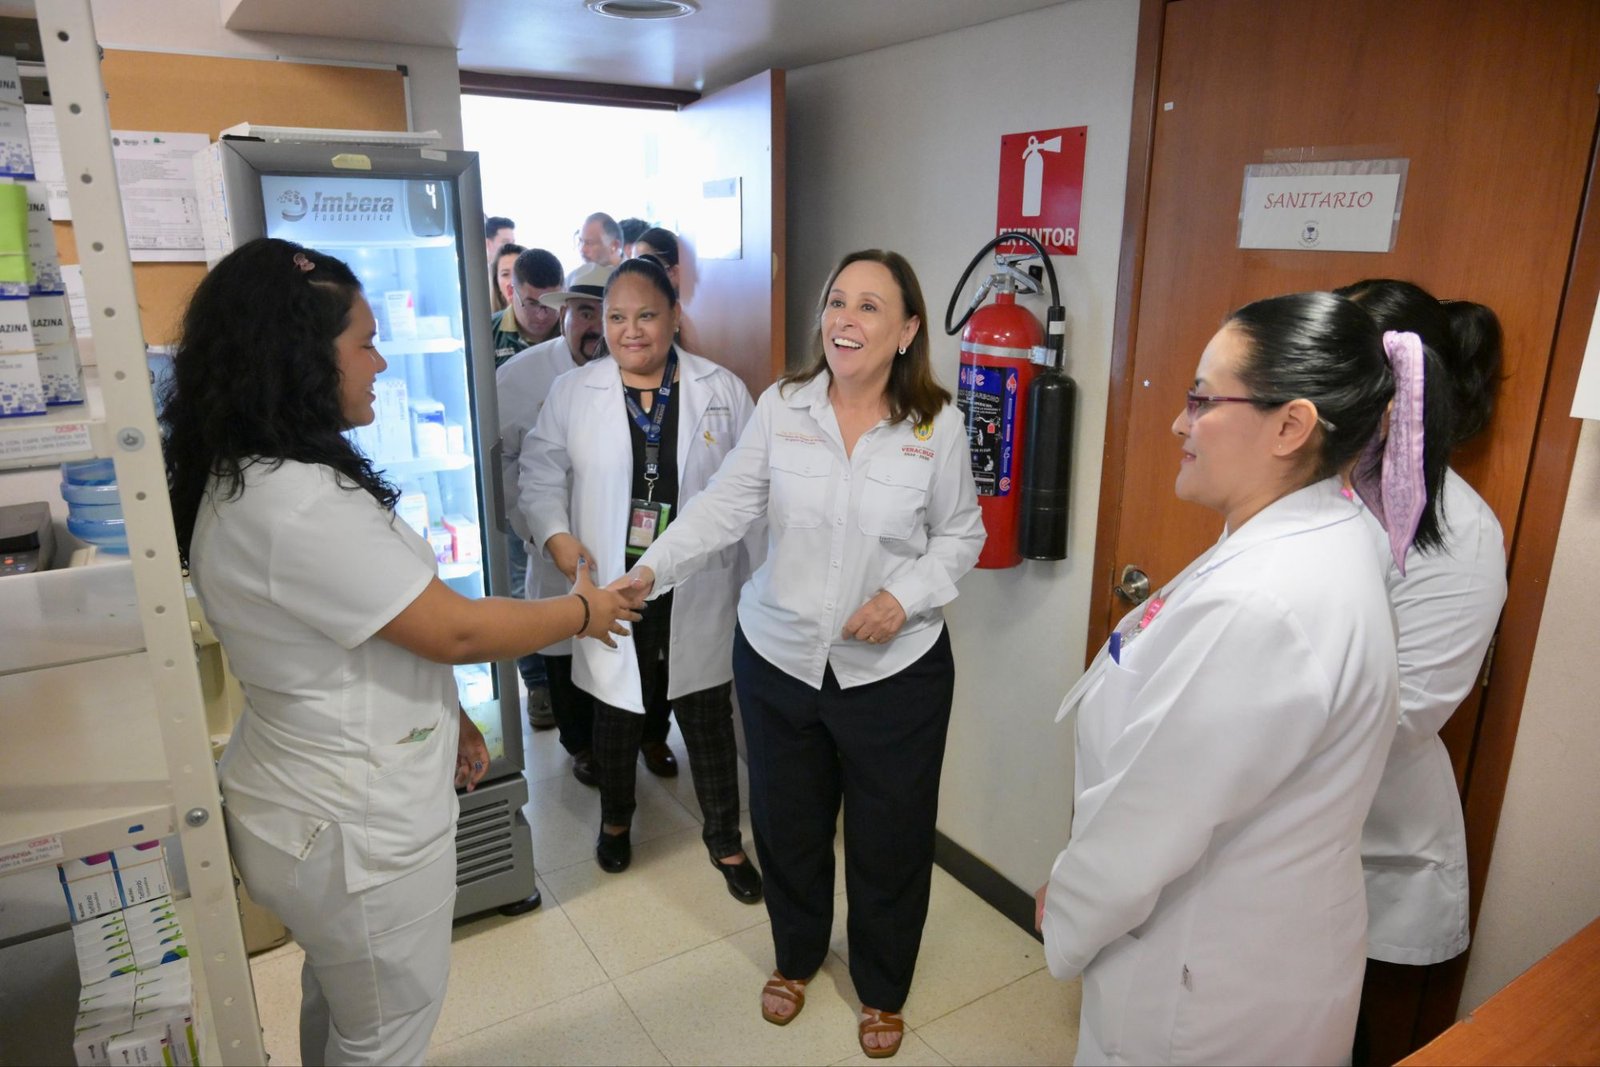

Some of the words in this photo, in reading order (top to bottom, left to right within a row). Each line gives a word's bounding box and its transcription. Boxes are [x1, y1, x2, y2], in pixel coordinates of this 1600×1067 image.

[312, 191, 395, 213] Imbera
[1264, 191, 1374, 210] SANITARIO
[901, 447, 935, 458] VERACRUZ
